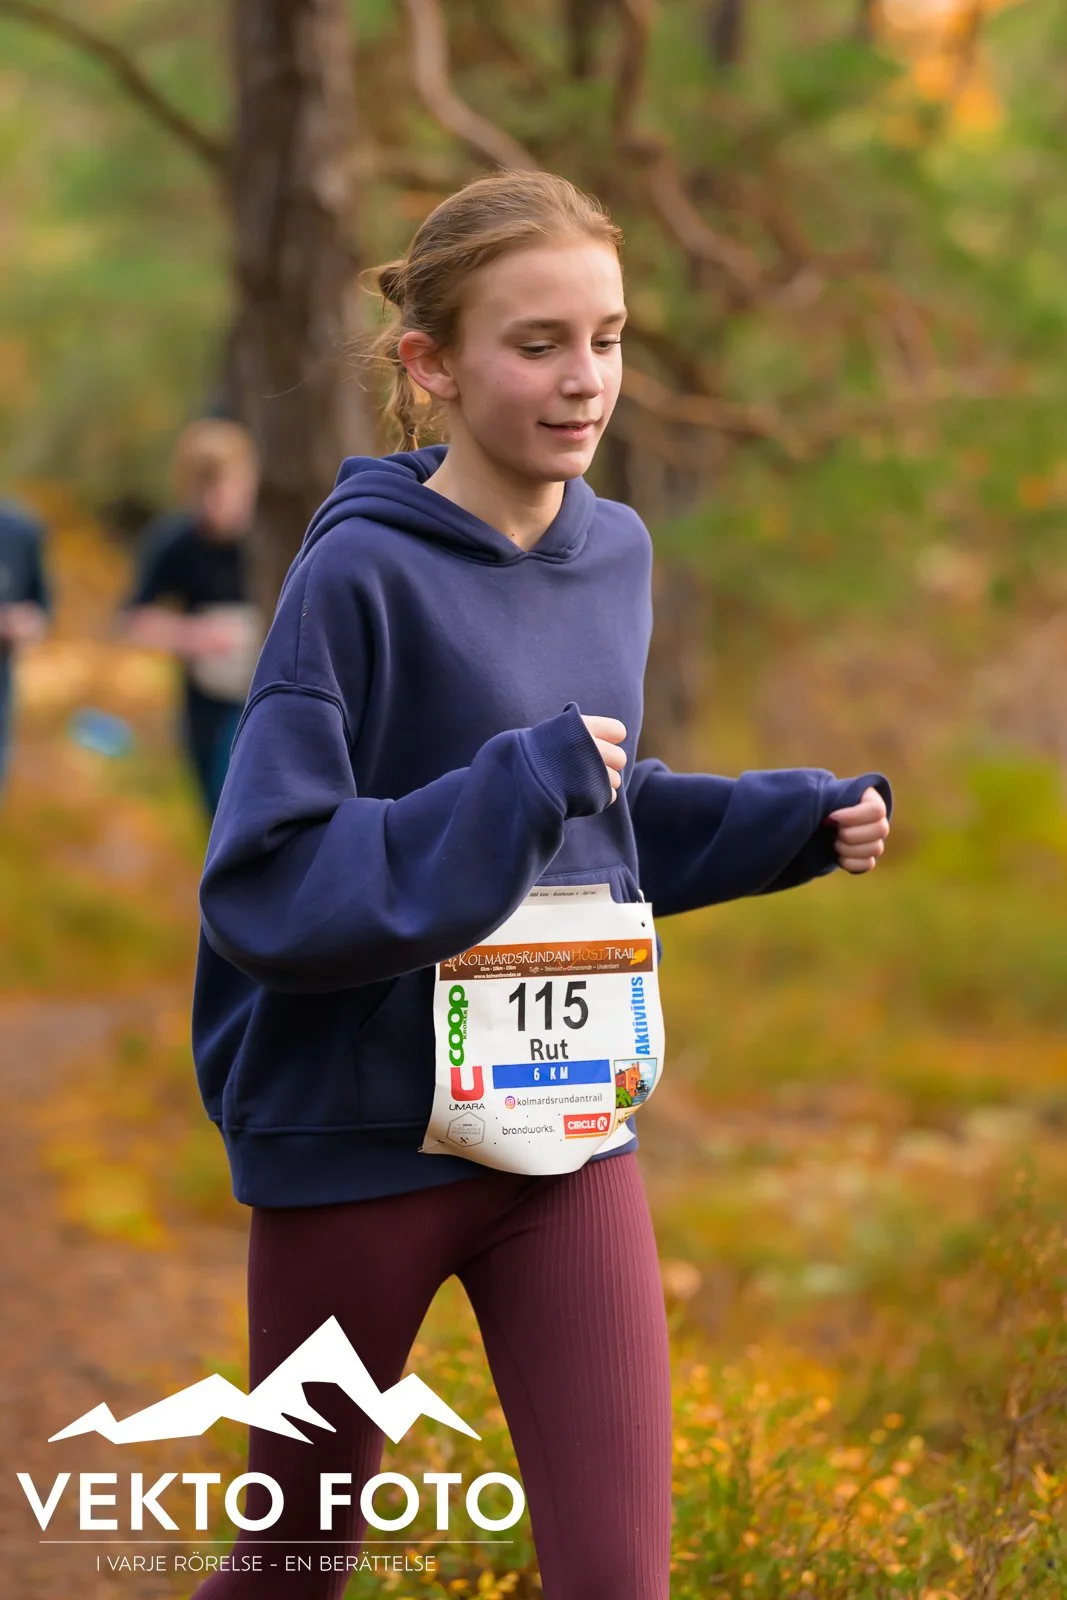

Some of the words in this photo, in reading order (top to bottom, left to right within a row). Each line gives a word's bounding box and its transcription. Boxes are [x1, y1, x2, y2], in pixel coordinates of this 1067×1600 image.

[508, 980, 589, 1031] 115
[630, 976, 650, 1055] Aktivitus
[448, 985, 468, 1066] coop
[530, 1038, 569, 1061] Rut
[533, 1068, 540, 1080] 6
[550, 1067, 569, 1080] KM
[449, 1103, 486, 1111] UMARA
[517, 1093, 603, 1106] kolmardsrundantrail
[567, 1120, 596, 1130] CIRCLE
